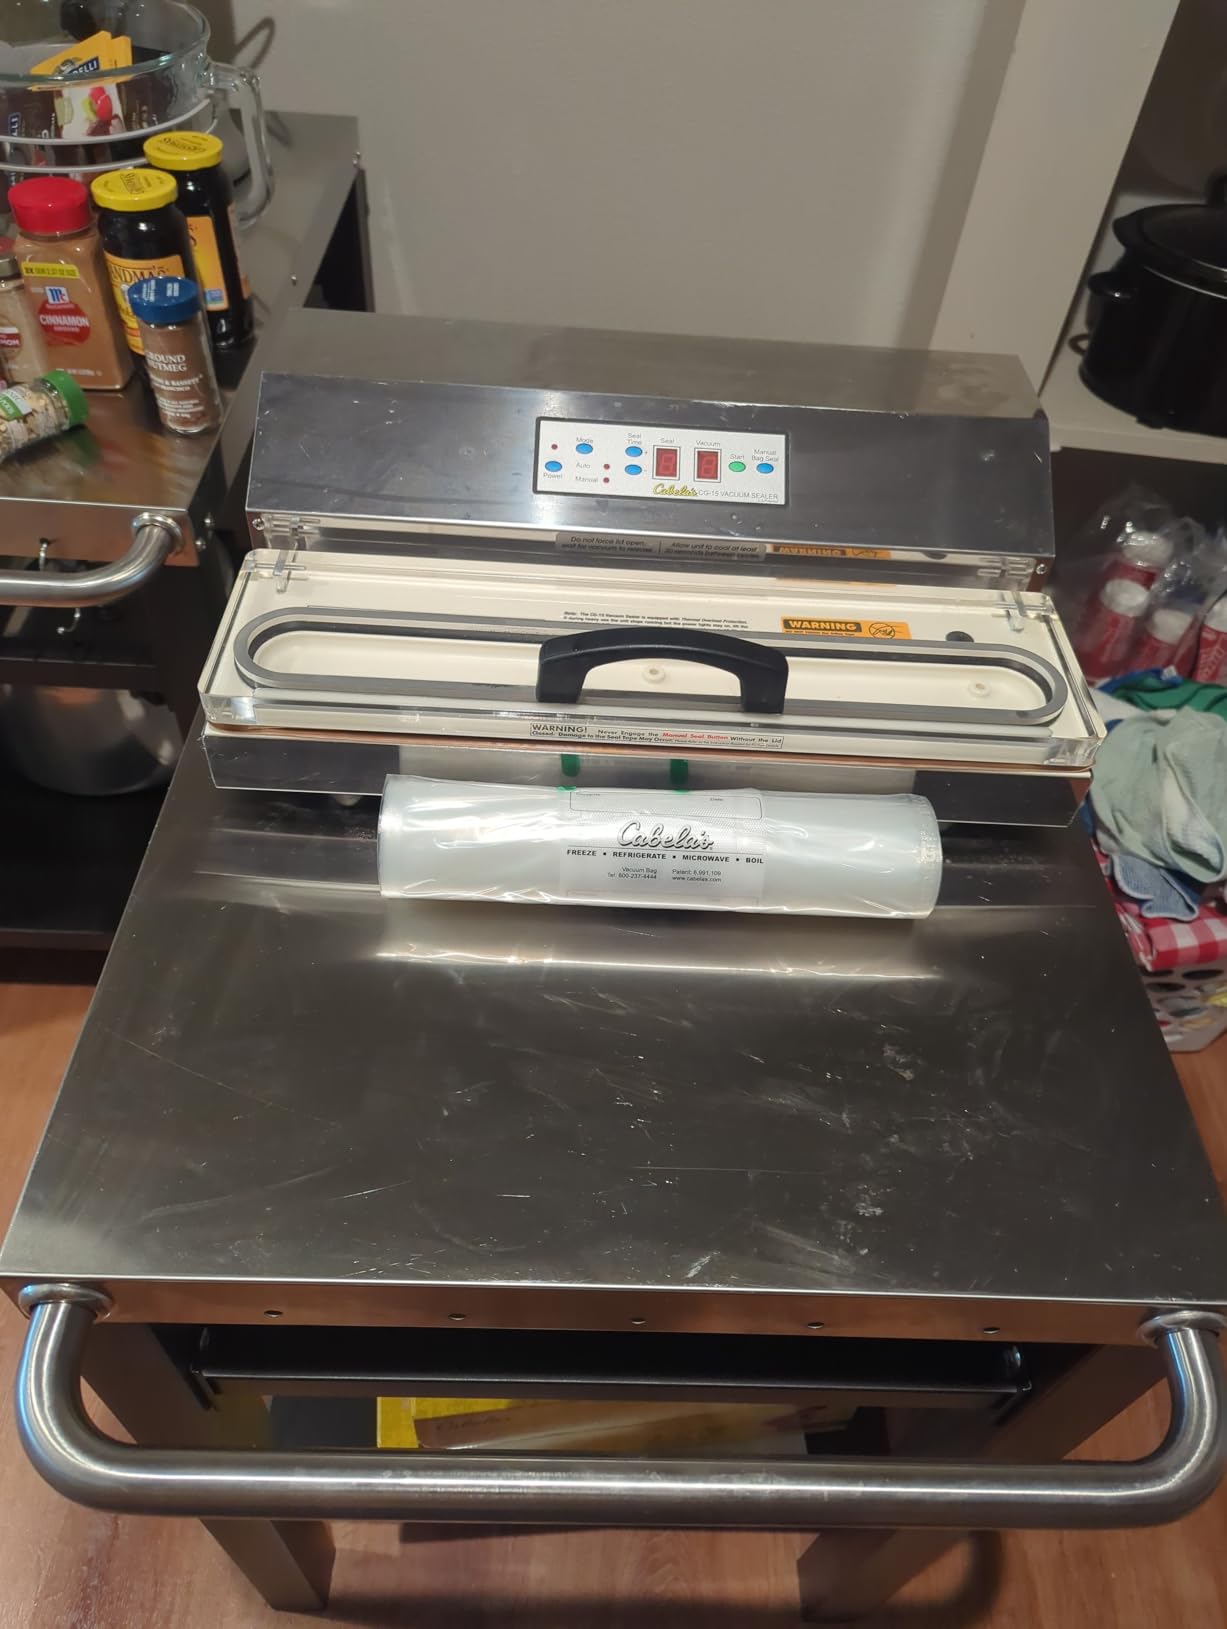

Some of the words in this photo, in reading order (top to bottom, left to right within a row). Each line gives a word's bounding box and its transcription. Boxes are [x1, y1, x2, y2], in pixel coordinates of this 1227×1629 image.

[39, 314, 90, 327] CINNAMON
[695, 440, 721, 448] Vacuum
[652, 482, 698, 497] Cabela's
[720, 490, 750, 498] VACUUM
[751, 492, 778, 500] SEALER
[788, 620, 857, 631] WARNING
[532, 723, 588, 733] WARNING!
[617, 821, 714, 850] Cabela's
[612, 851, 667, 860] REFRIGERATE
[682, 854, 730, 863] MICROWAVE
[645, 867, 658, 875] Bag
[672, 875, 722, 883] www.cabelas.com
